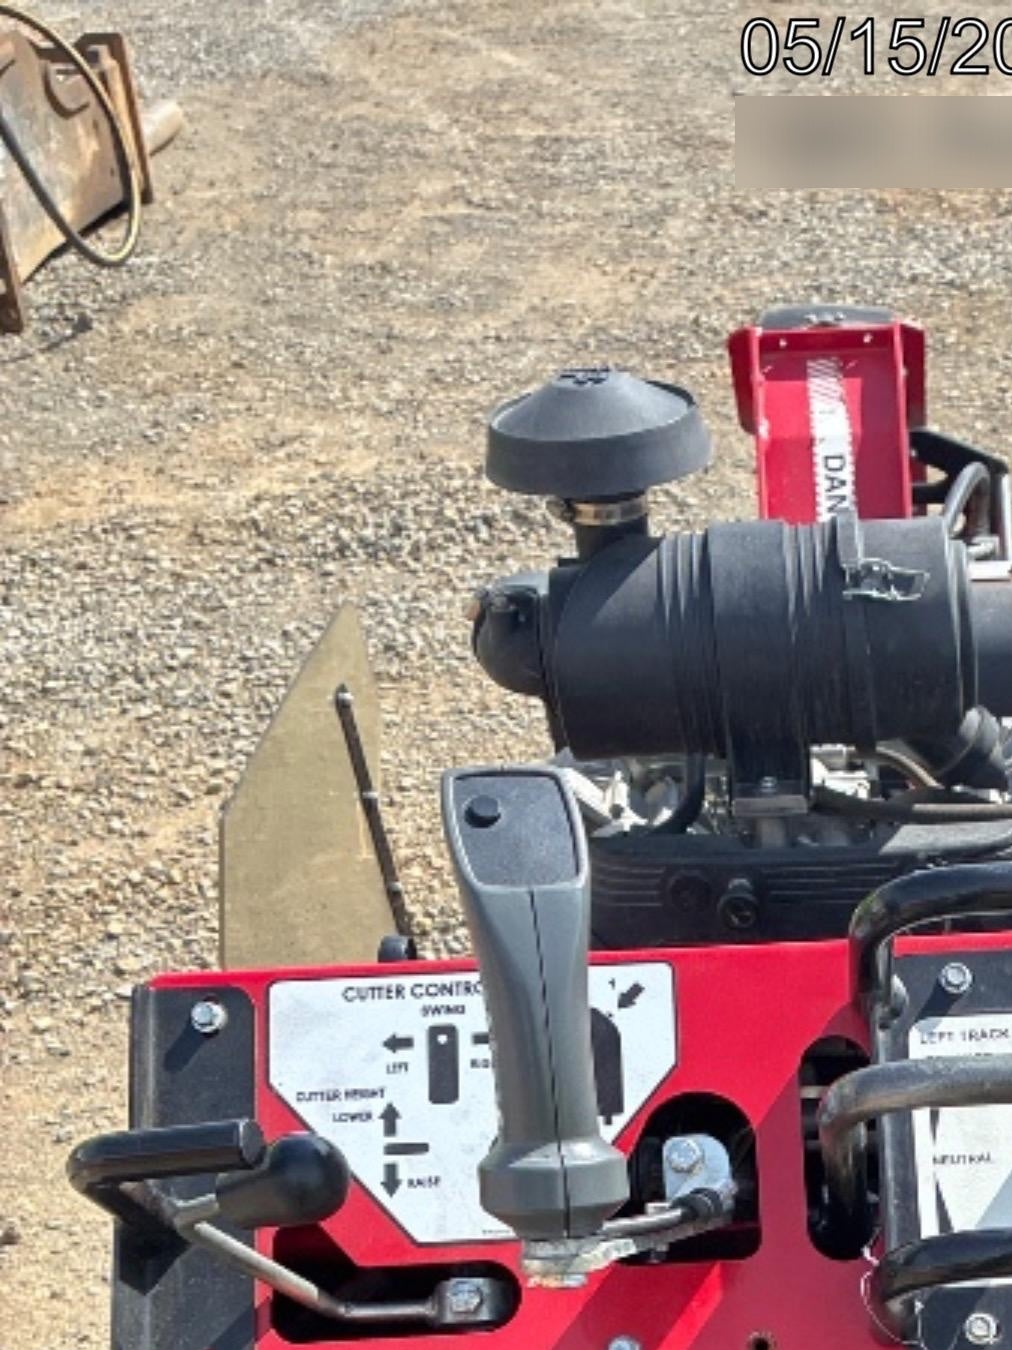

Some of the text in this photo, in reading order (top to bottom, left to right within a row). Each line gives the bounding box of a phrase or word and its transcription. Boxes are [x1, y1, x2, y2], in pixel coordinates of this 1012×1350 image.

[823, 454, 847, 513] DAN
[341, 980, 482, 1002] CUTTER CONTRO
[421, 1004, 466, 1017] SWING
[920, 1027, 1010, 1045] LEFT TRACK
[386, 1061, 409, 1075] LEFT
[296, 1087, 386, 1102] CUTTER HEIGHT
[332, 1110, 374, 1123] LOWER
[932, 1151, 993, 1166] NEUTRAL
[407, 1176, 441, 1189] RAISE
